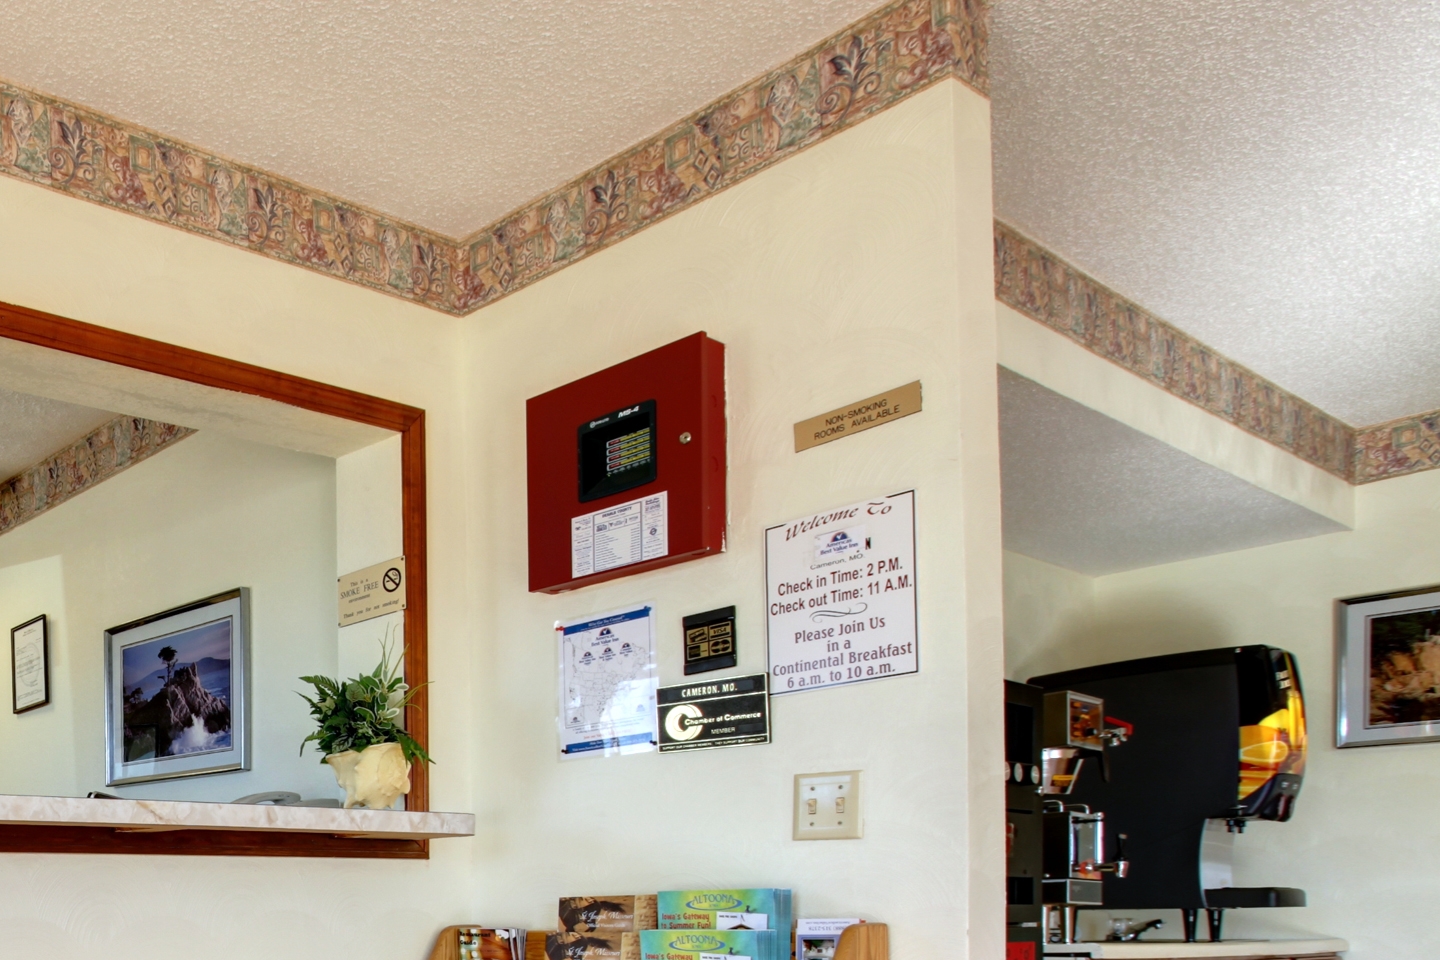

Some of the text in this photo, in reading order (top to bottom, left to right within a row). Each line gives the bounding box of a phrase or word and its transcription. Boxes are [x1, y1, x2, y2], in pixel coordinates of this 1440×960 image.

[618, 406, 639, 418] MS-4
[825, 399, 887, 426] NON-SMOKING
[814, 404, 900, 440] ROOMS AVAILABLE
[785, 502, 892, 541] Welcome To
[820, 547, 832, 556] Best
[833, 545, 847, 553] Value
[810, 559, 847, 570] Cameron,
[778, 557, 903, 596] Check in Time: 2 P.M.
[340, 581, 379, 599] SMOKE FREE
[771, 575, 912, 616] Check out Time: 11 A.M.
[713, 627, 727, 635] VISA
[795, 617, 885, 643] Please Join Us
[827, 640, 851, 652] in a
[773, 642, 912, 676] Continental Breakfast
[787, 663, 896, 688] 6 a.m. to 10 a.m.
[722, 683, 737, 693] MO.
[684, 716, 715, 726] Chamber
[724, 712, 761, 721] Commerce
[692, 893, 735, 905] ALTOONA
[683, 913, 710, 921] Gateway
[675, 935, 718, 945] ALTOONA
